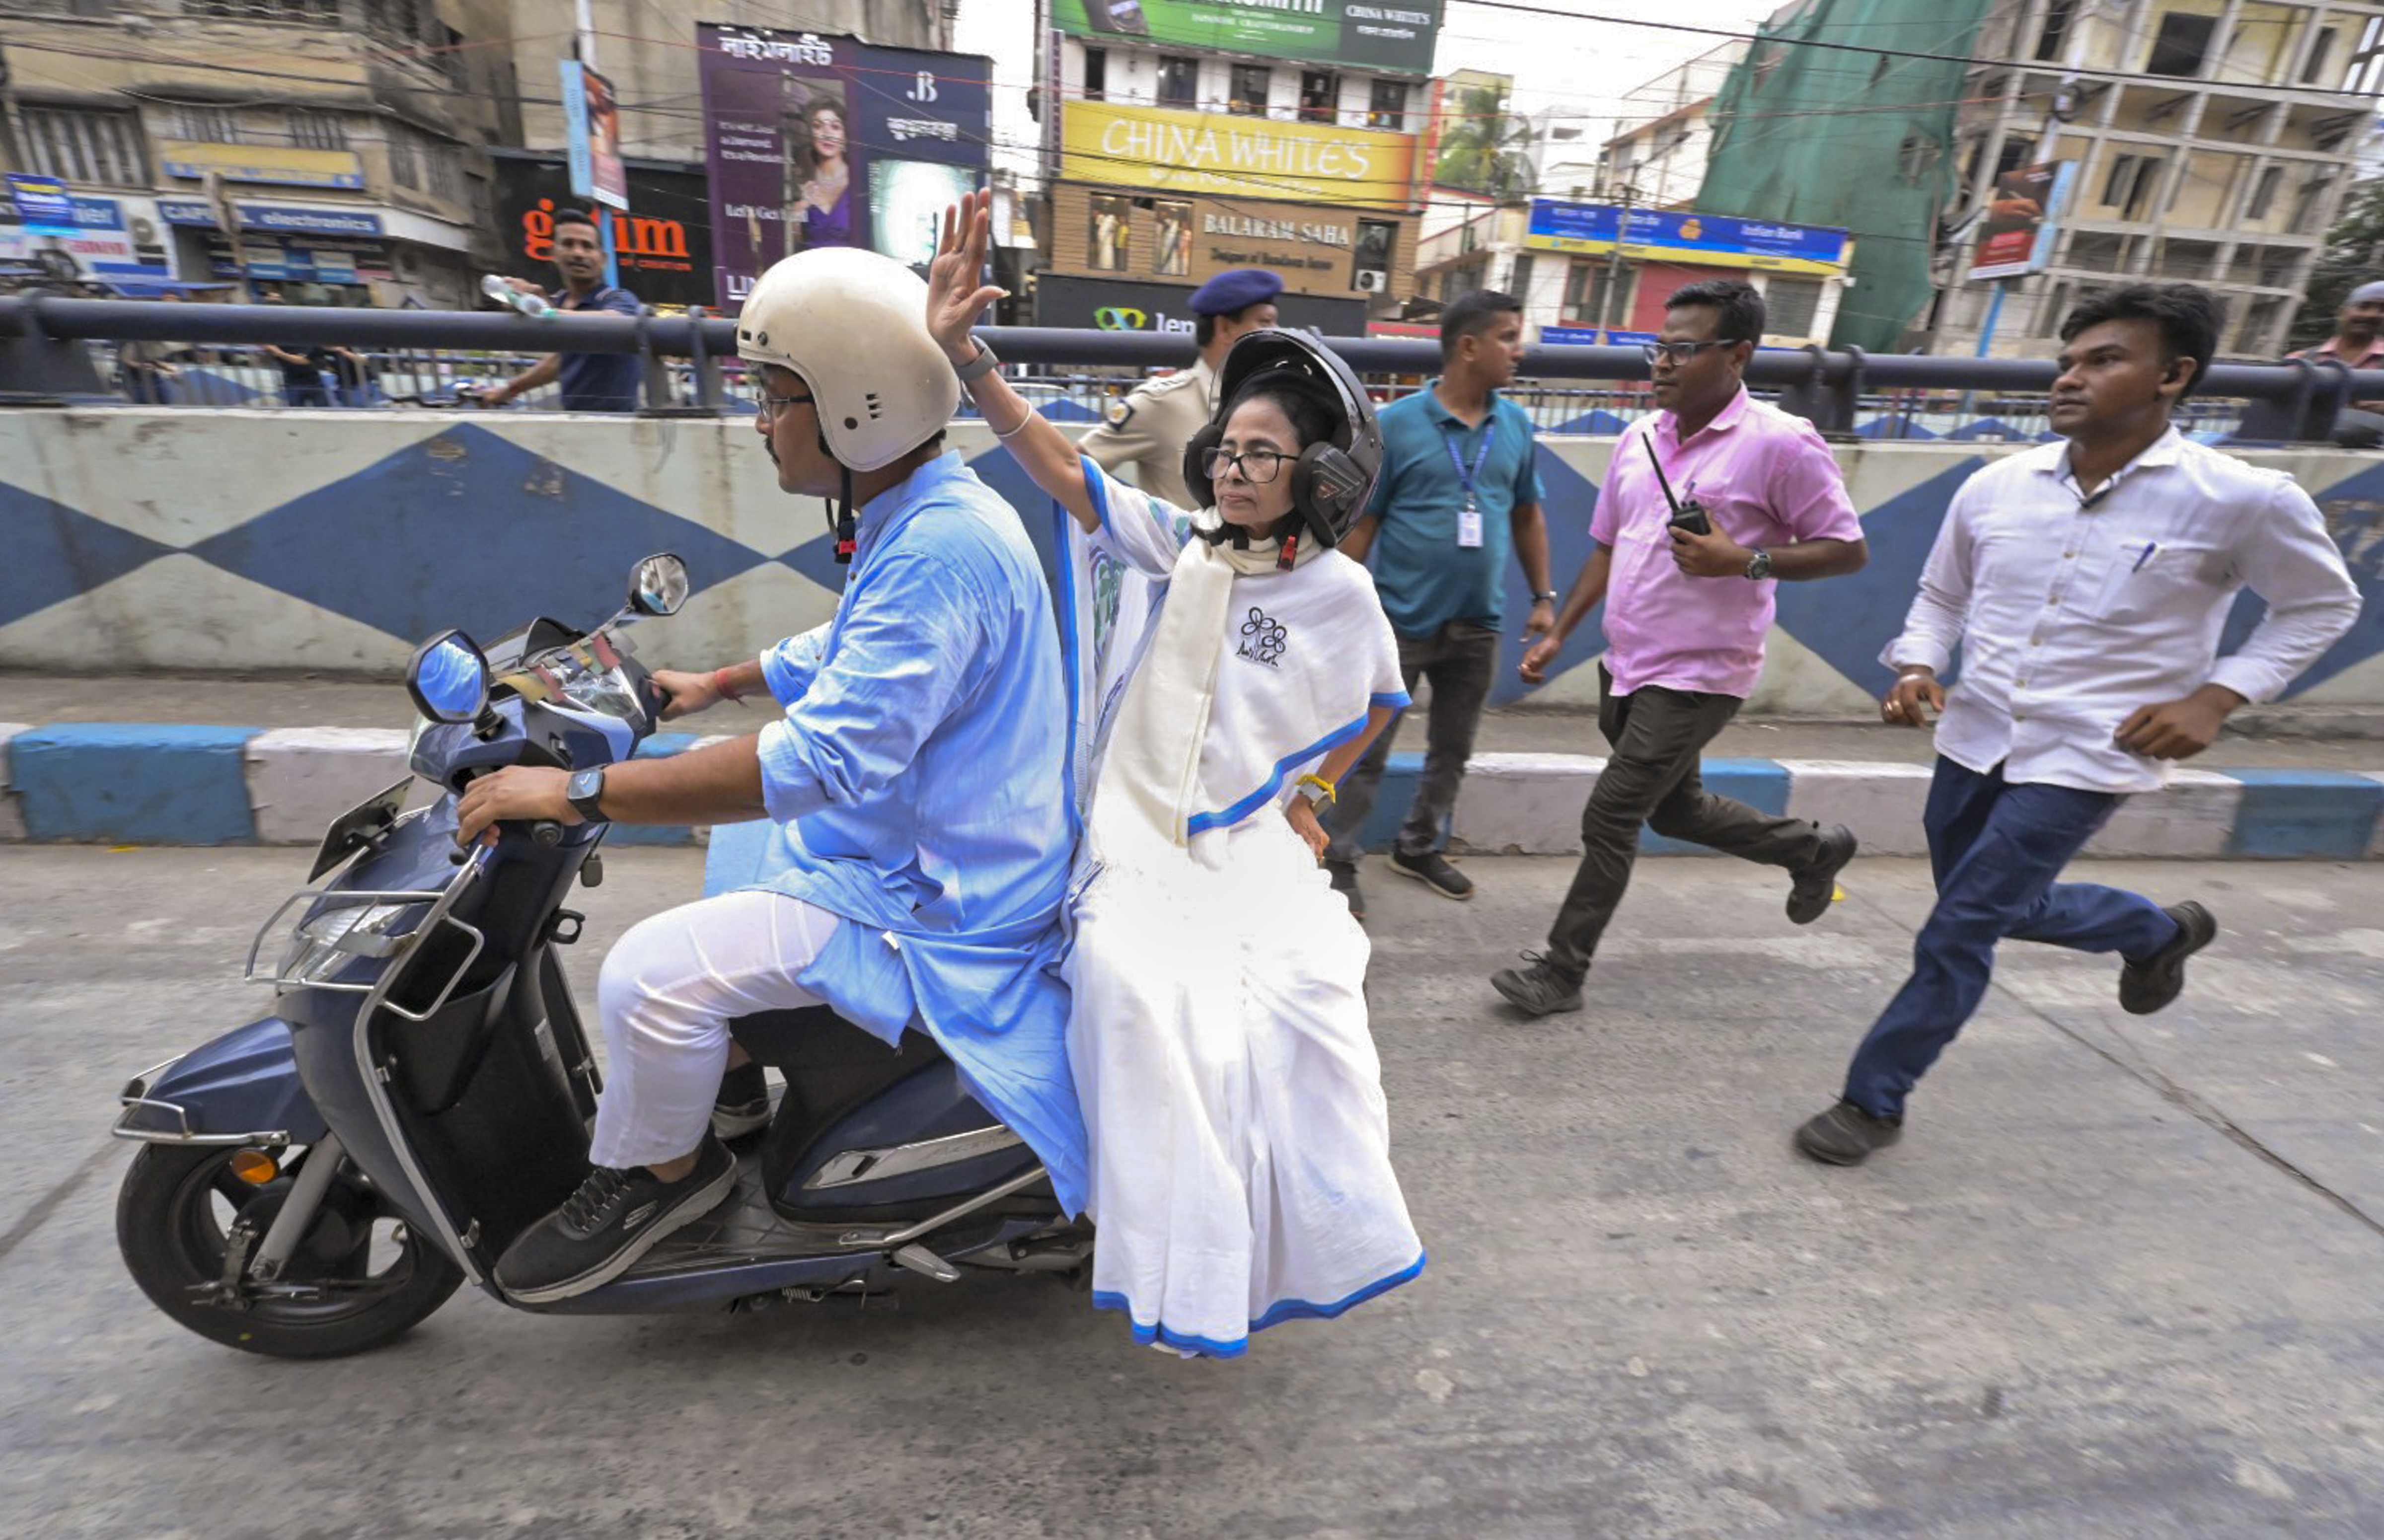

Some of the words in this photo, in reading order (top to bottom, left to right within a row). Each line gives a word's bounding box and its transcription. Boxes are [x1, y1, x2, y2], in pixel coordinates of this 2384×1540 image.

[1102, 119, 1220, 167] CHINA
[261, 212, 376, 232] electronics
[1204, 214, 1295, 241] BALARAM
[1301, 223, 1349, 245] SAHA
